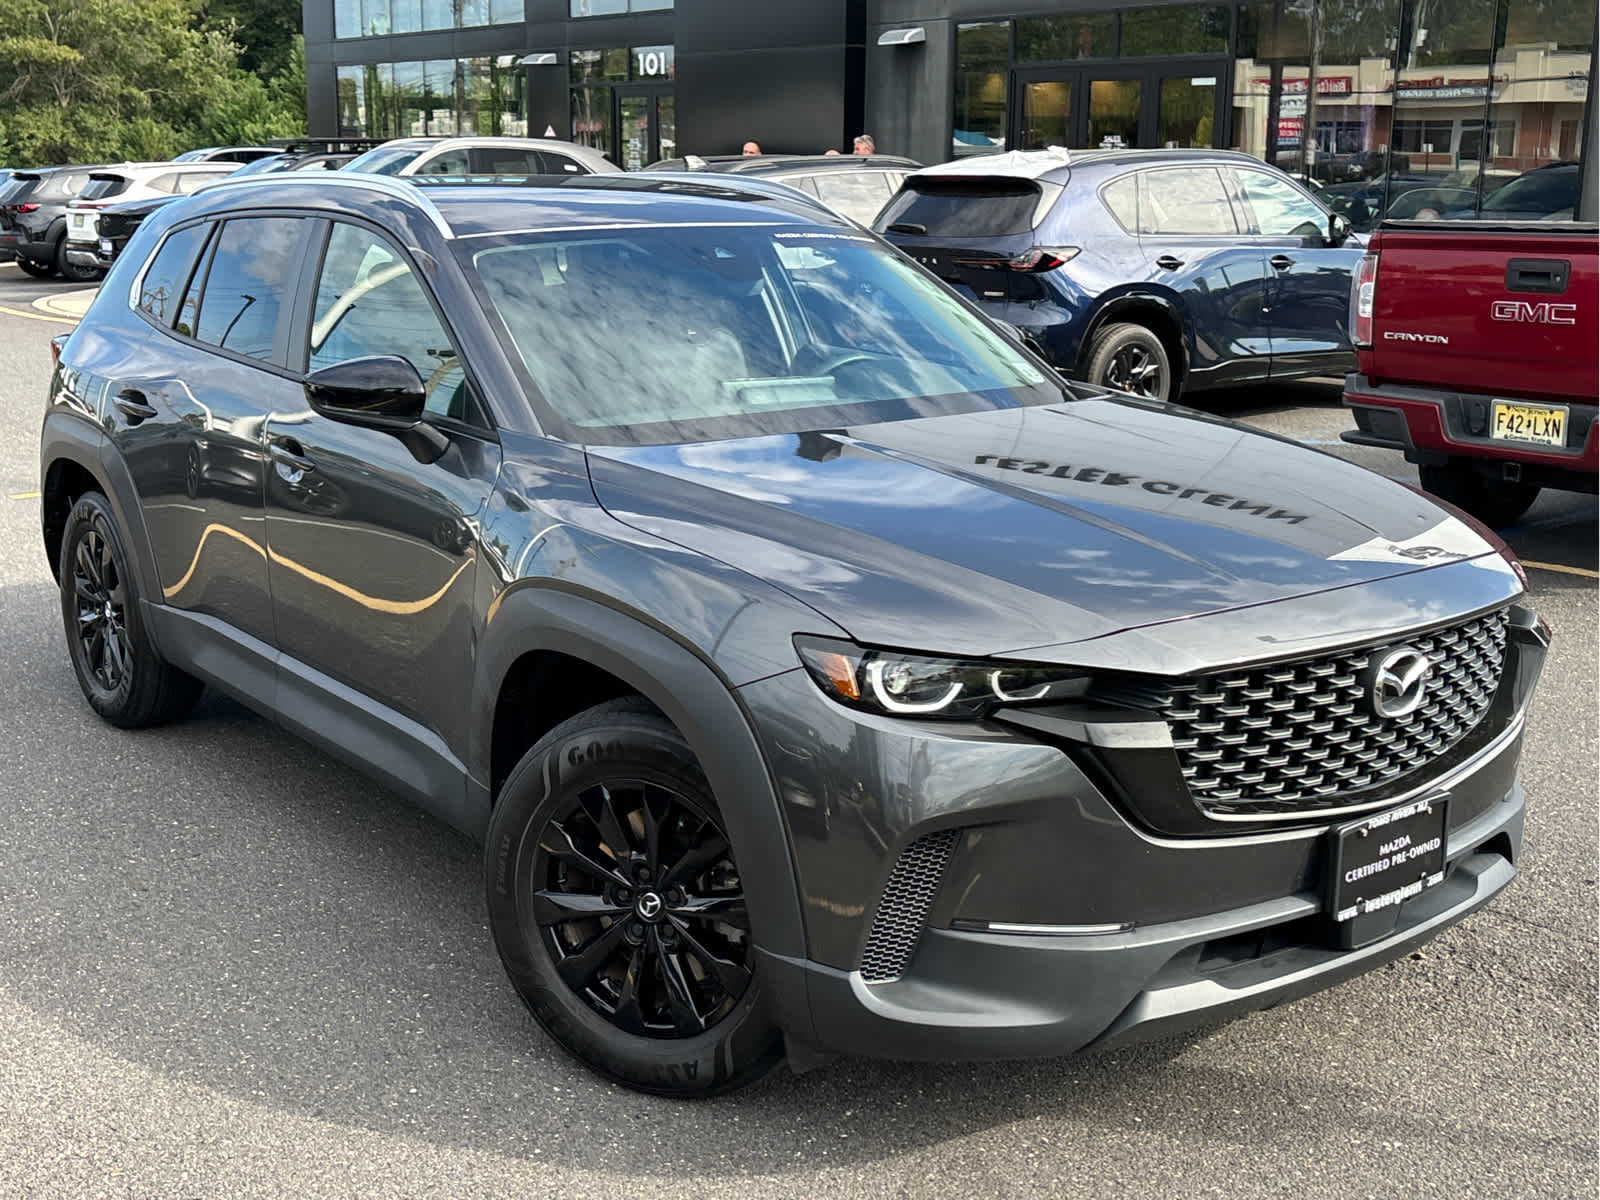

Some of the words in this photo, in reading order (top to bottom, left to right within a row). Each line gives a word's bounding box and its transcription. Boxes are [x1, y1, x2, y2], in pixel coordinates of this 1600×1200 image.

[638, 52, 666, 76] 101
[1490, 301, 1577, 325] GMC
[1384, 332, 1449, 344] CANYON
[1379, 834, 1412, 856] MAZDA
[1345, 858, 1390, 883] CERTIFIED
[1391, 837, 1441, 866] PRE-OWNED
